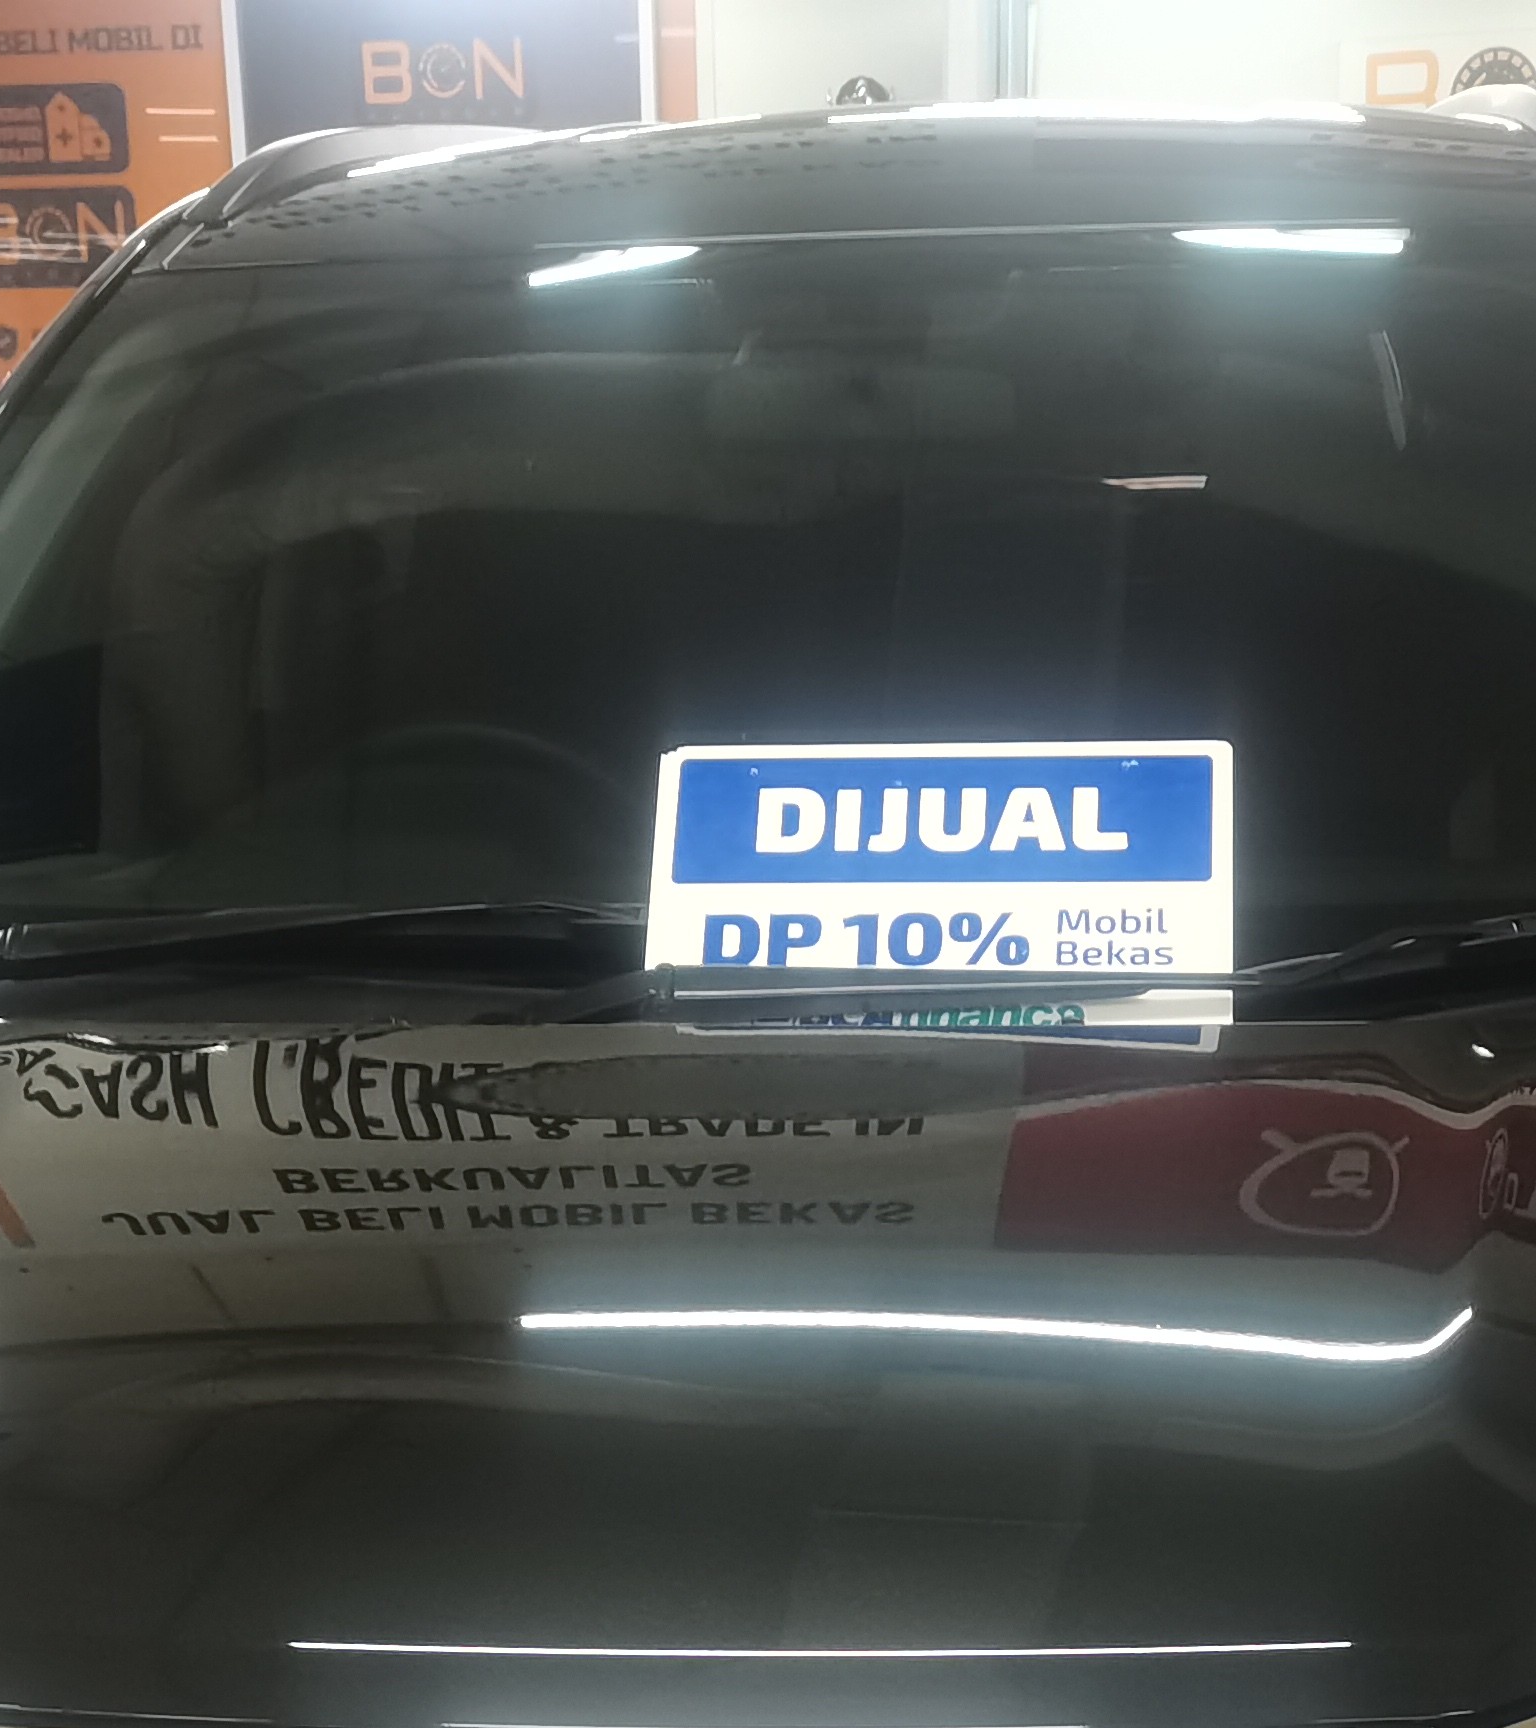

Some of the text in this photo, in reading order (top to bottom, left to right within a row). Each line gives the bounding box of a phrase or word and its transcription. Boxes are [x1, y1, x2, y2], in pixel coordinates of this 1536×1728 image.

[69, 26, 162, 53] MOBIL
[171, 24, 204, 50] DI
[755, 786, 1129, 854] DIJUAL
[1056, 908, 1169, 936] Mobil
[701, 911, 1030, 967] DP 10%
[1055, 940, 1174, 967] Bekas
